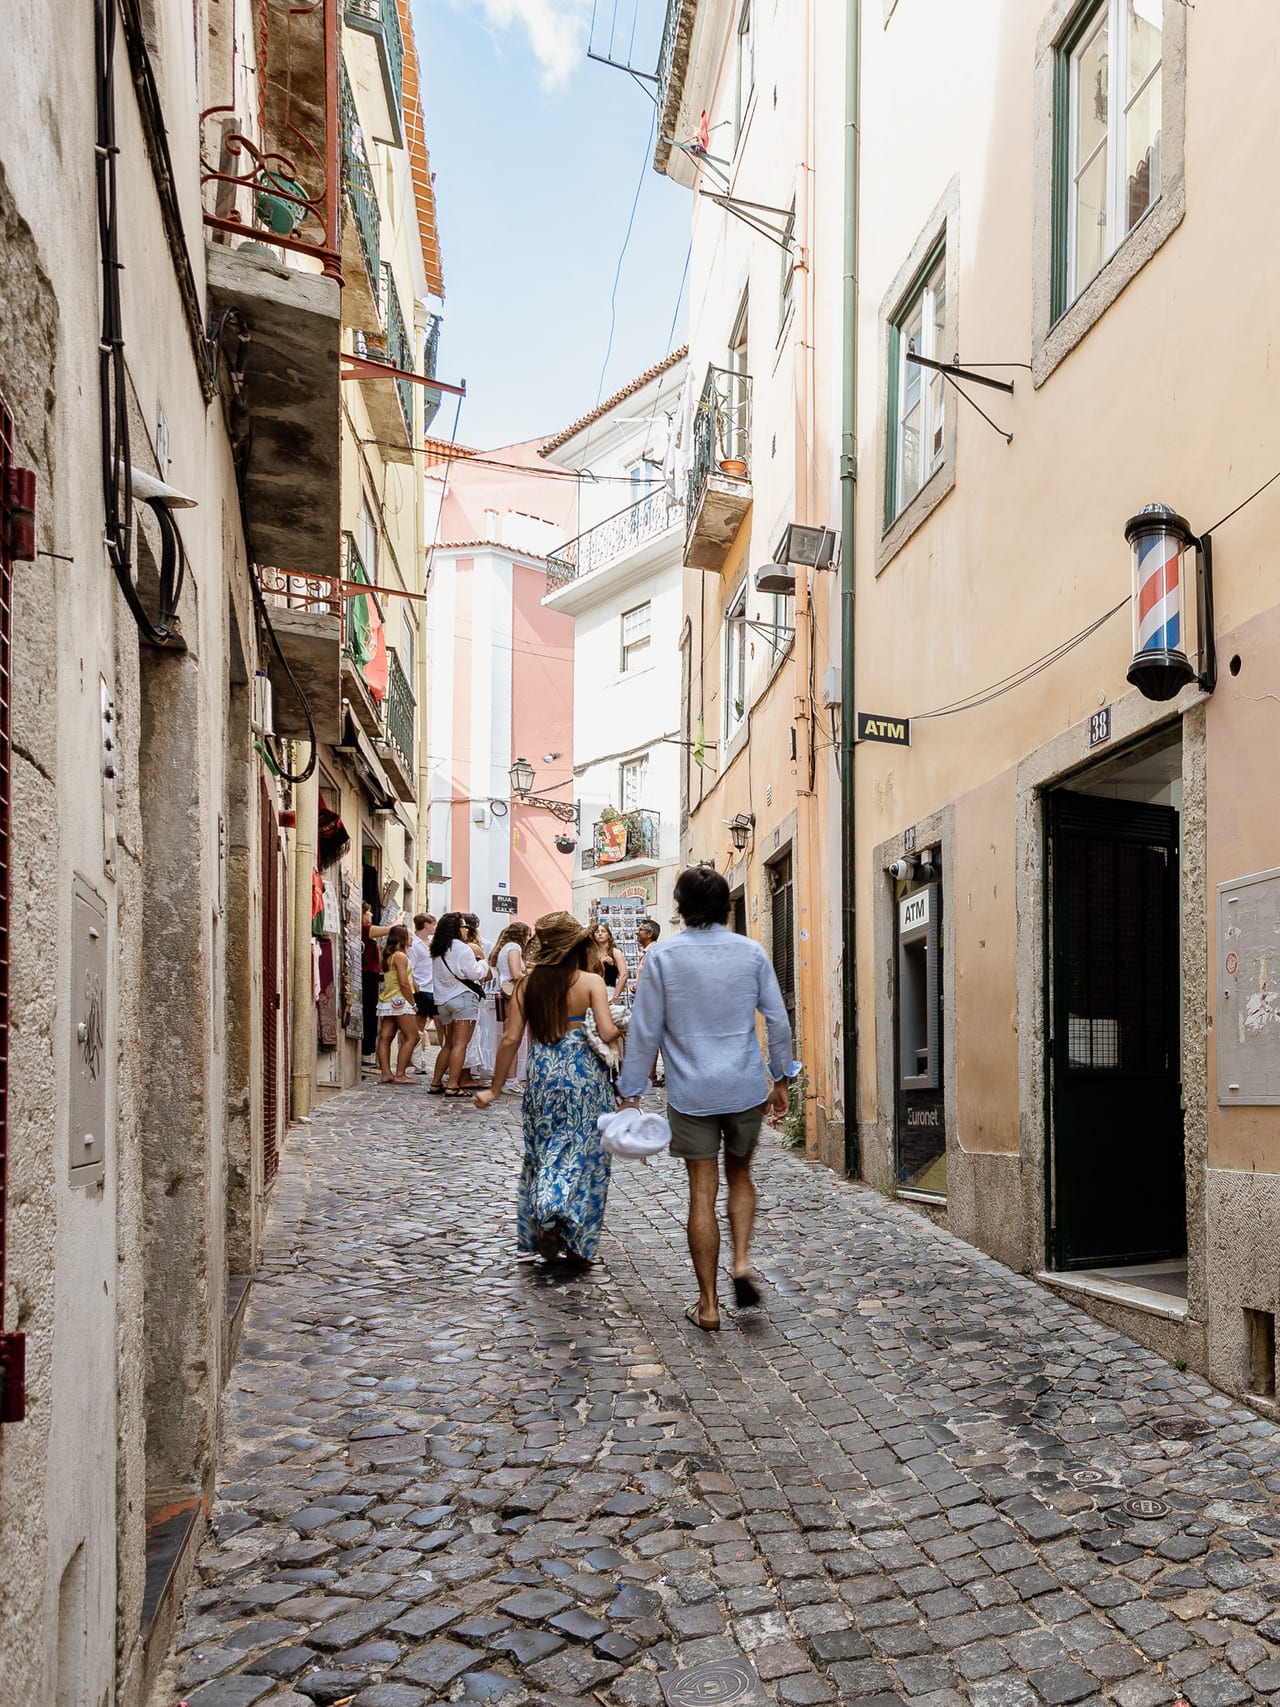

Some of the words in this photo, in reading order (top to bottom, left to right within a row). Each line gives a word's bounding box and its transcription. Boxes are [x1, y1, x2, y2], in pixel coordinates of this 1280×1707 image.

[864, 719, 905, 739] ATM
[1092, 711, 1107, 741] 38
[905, 898, 925, 924] ATM
[907, 1107, 939, 1126] Euronet
